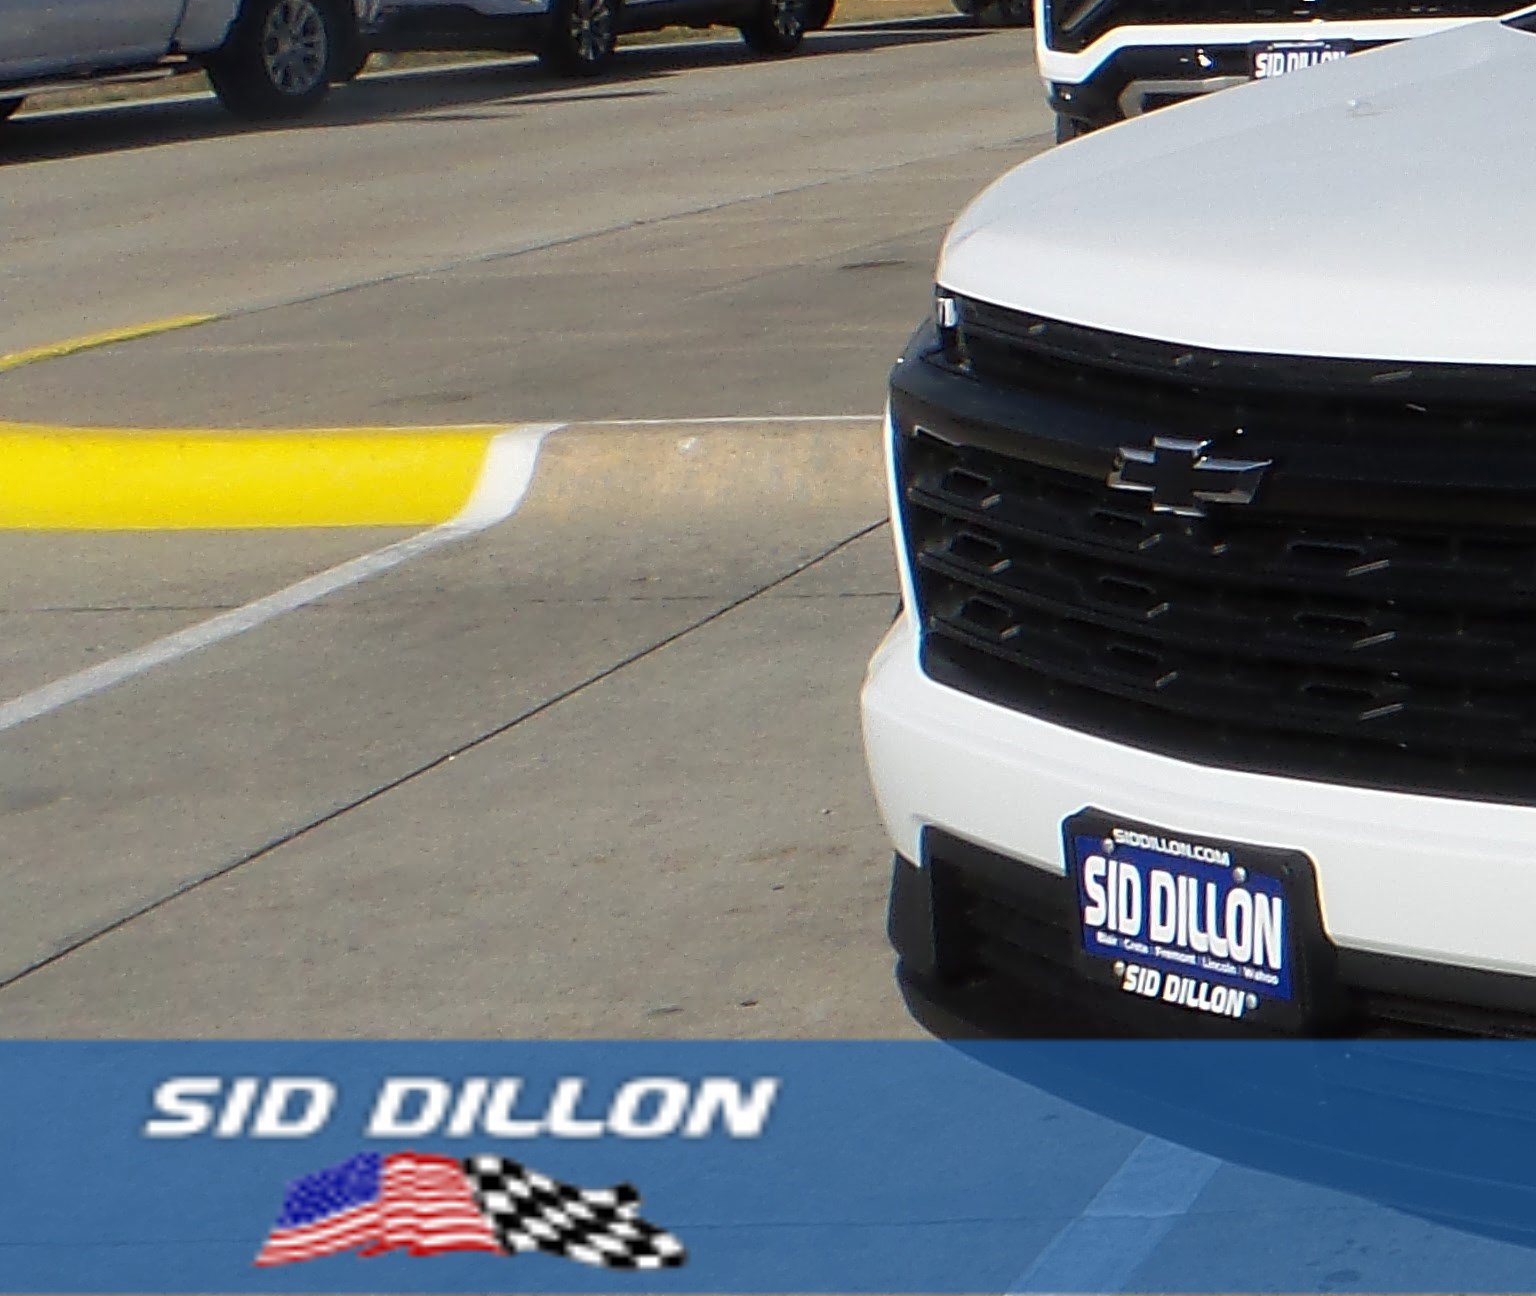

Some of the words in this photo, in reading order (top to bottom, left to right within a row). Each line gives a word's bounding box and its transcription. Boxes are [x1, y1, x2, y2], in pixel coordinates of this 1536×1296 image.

[1255, 52, 1285, 78] SID
[1113, 828, 1230, 867] SIDDILLON.COM
[1084, 854, 1142, 937] SID
[1149, 868, 1282, 970] DILLON
[1122, 964, 1161, 998] SID
[1163, 973, 1245, 1018] DILLON
